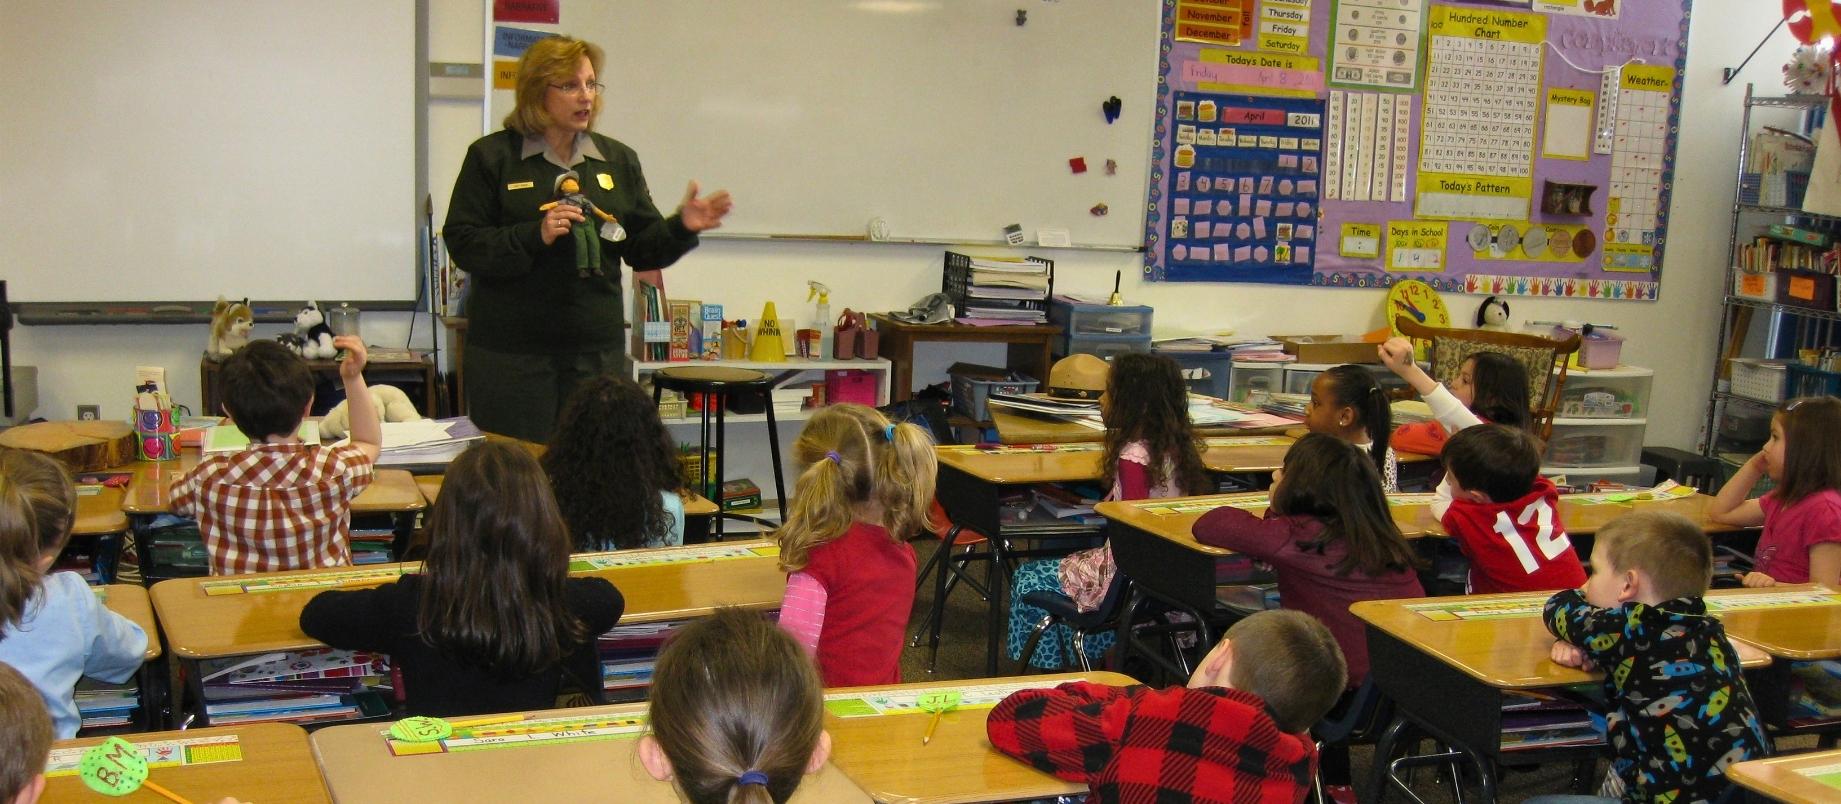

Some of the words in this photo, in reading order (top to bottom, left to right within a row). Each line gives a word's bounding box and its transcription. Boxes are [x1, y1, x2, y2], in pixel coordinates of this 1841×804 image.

[1187, 10, 1233, 23] November
[1268, 8, 1303, 21] Thursday
[1449, 11, 1488, 24] Hundred
[1492, 17, 1528, 28] Number
[1186, 27, 1231, 39] December
[1272, 24, 1297, 36] Friday
[1474, 27, 1501, 39] Chart
[1265, 40, 1301, 53] Saturday
[1261, 57, 1282, 69] Date
[1285, 59, 1293, 69] is
[1627, 75, 1666, 87] Weather
[1551, 94, 1577, 104] Mystery
[1579, 96, 1591, 105] Bag
[1243, 111, 1265, 121] April
[1307, 158, 1314, 171] 2
[1200, 178, 1207, 189] 4
[1242, 177, 1250, 191] 6
[1263, 178, 1272, 190] 7
[1475, 182, 1511, 193] Pattern
[1351, 226, 1371, 237] Time
[1391, 227, 1409, 238] Days
[1411, 228, 1418, 236] in
[1420, 227, 1444, 237] School
[1409, 285, 1419, 295] 12
[1424, 289, 1428, 299] 1
[1432, 299, 1441, 309] 2
[764, 319, 775, 328] NO
[1439, 314, 1446, 324] 3
[1493, 496, 1571, 575] 12
[552, 729, 597, 738] White
